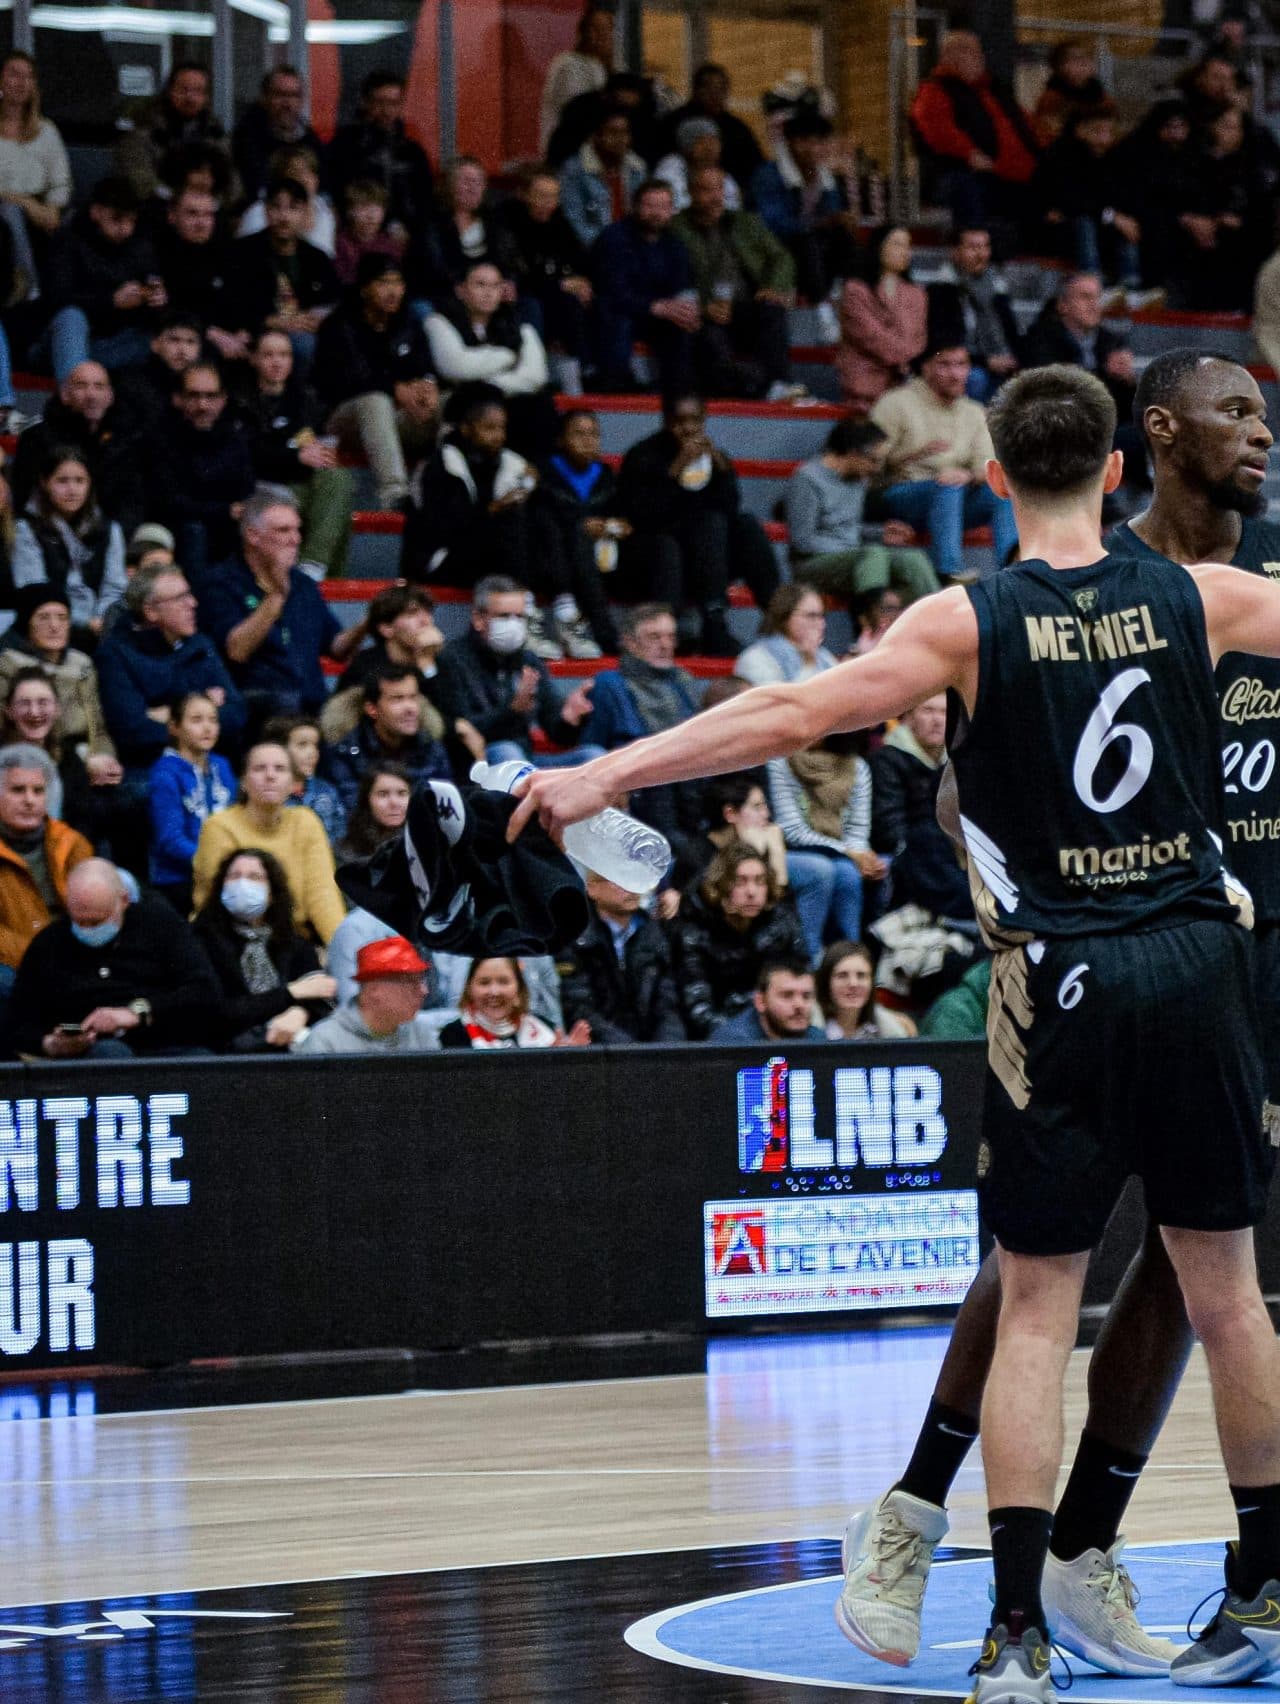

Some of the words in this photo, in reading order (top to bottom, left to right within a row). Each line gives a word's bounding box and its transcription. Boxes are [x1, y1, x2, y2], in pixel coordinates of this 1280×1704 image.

[1025, 604, 1168, 662] MEYNIEL
[1073, 668, 1153, 813] 6
[1222, 740, 1275, 794] 20
[1059, 832, 1191, 876] mariot
[1058, 963, 1090, 1010] 6
[789, 1065, 948, 1170] LNB
[775, 1245, 817, 1274] DE
